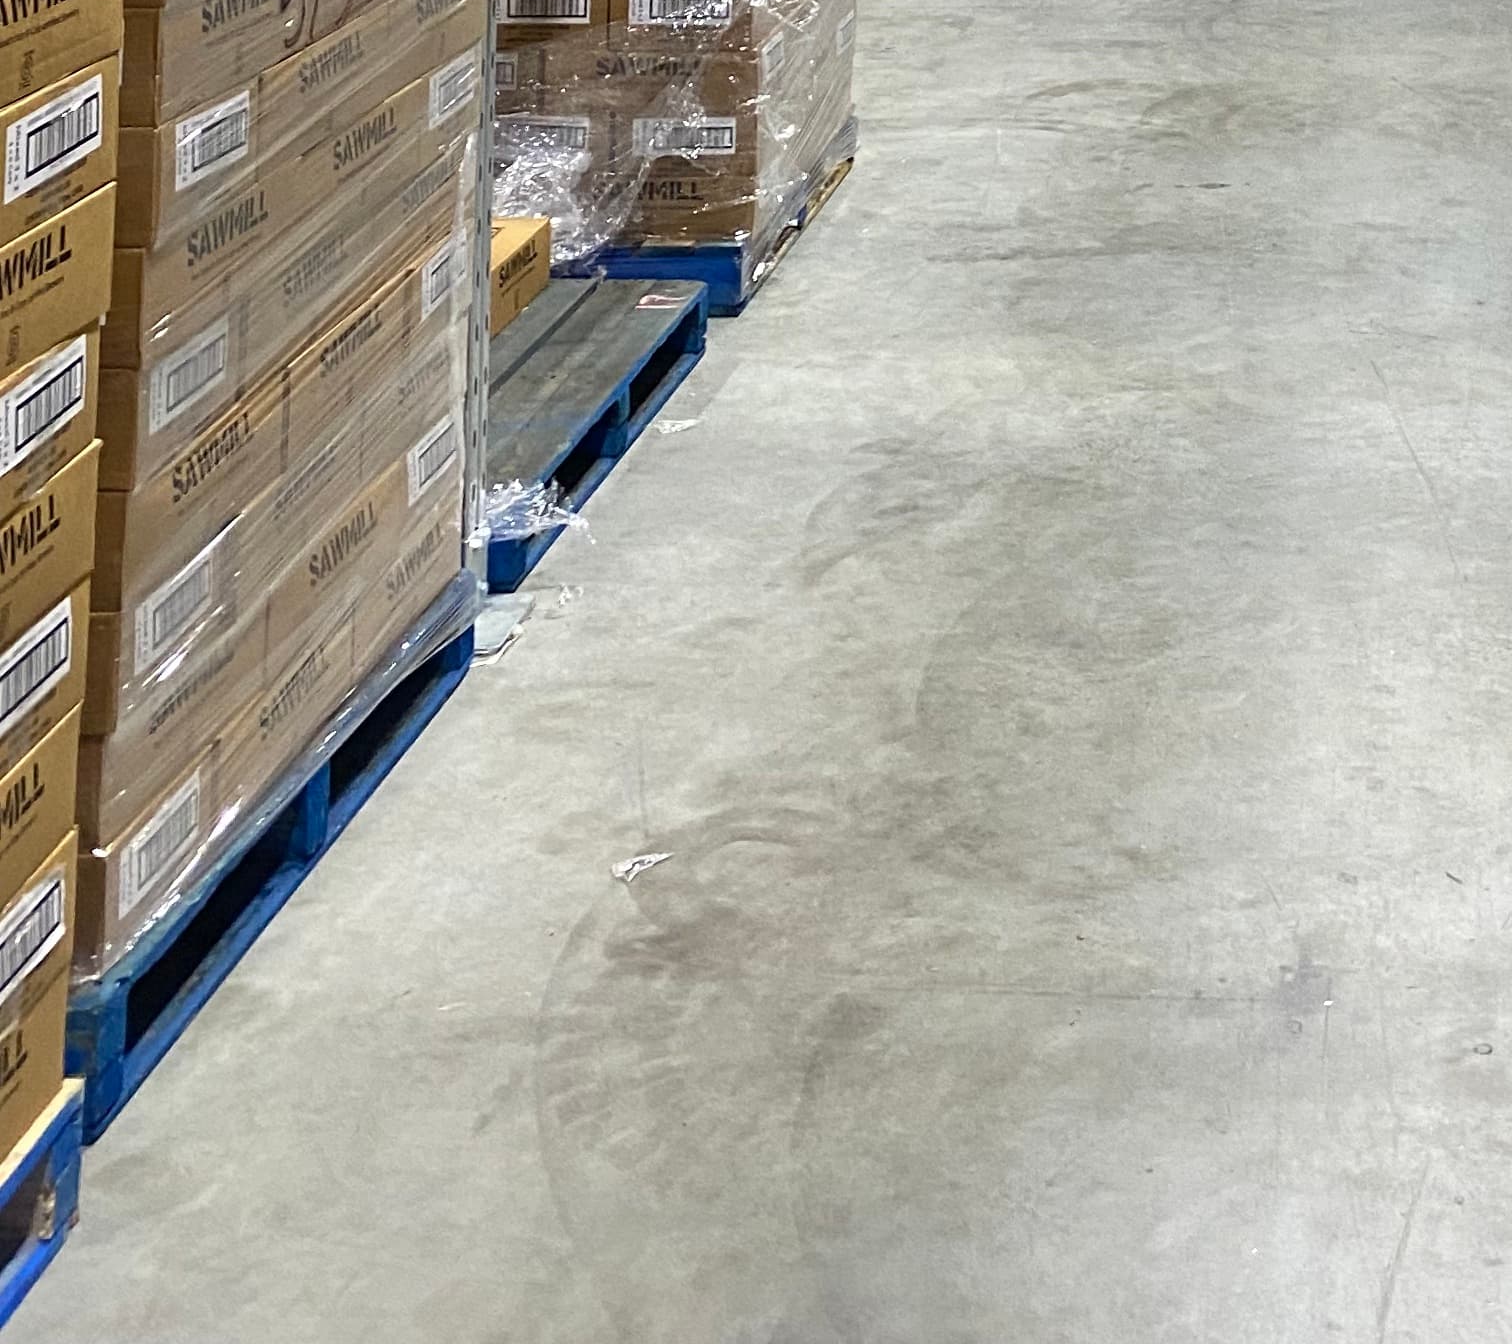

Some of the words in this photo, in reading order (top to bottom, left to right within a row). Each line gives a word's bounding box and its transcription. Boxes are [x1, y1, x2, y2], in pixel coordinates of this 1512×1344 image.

[333, 106, 398, 170] SAWMILL
[0, 224, 72, 300] WMILL
[187, 192, 269, 266] SAWMILL
[0, 495, 61, 575] MILL
[309, 500, 379, 587] SAWMILL
